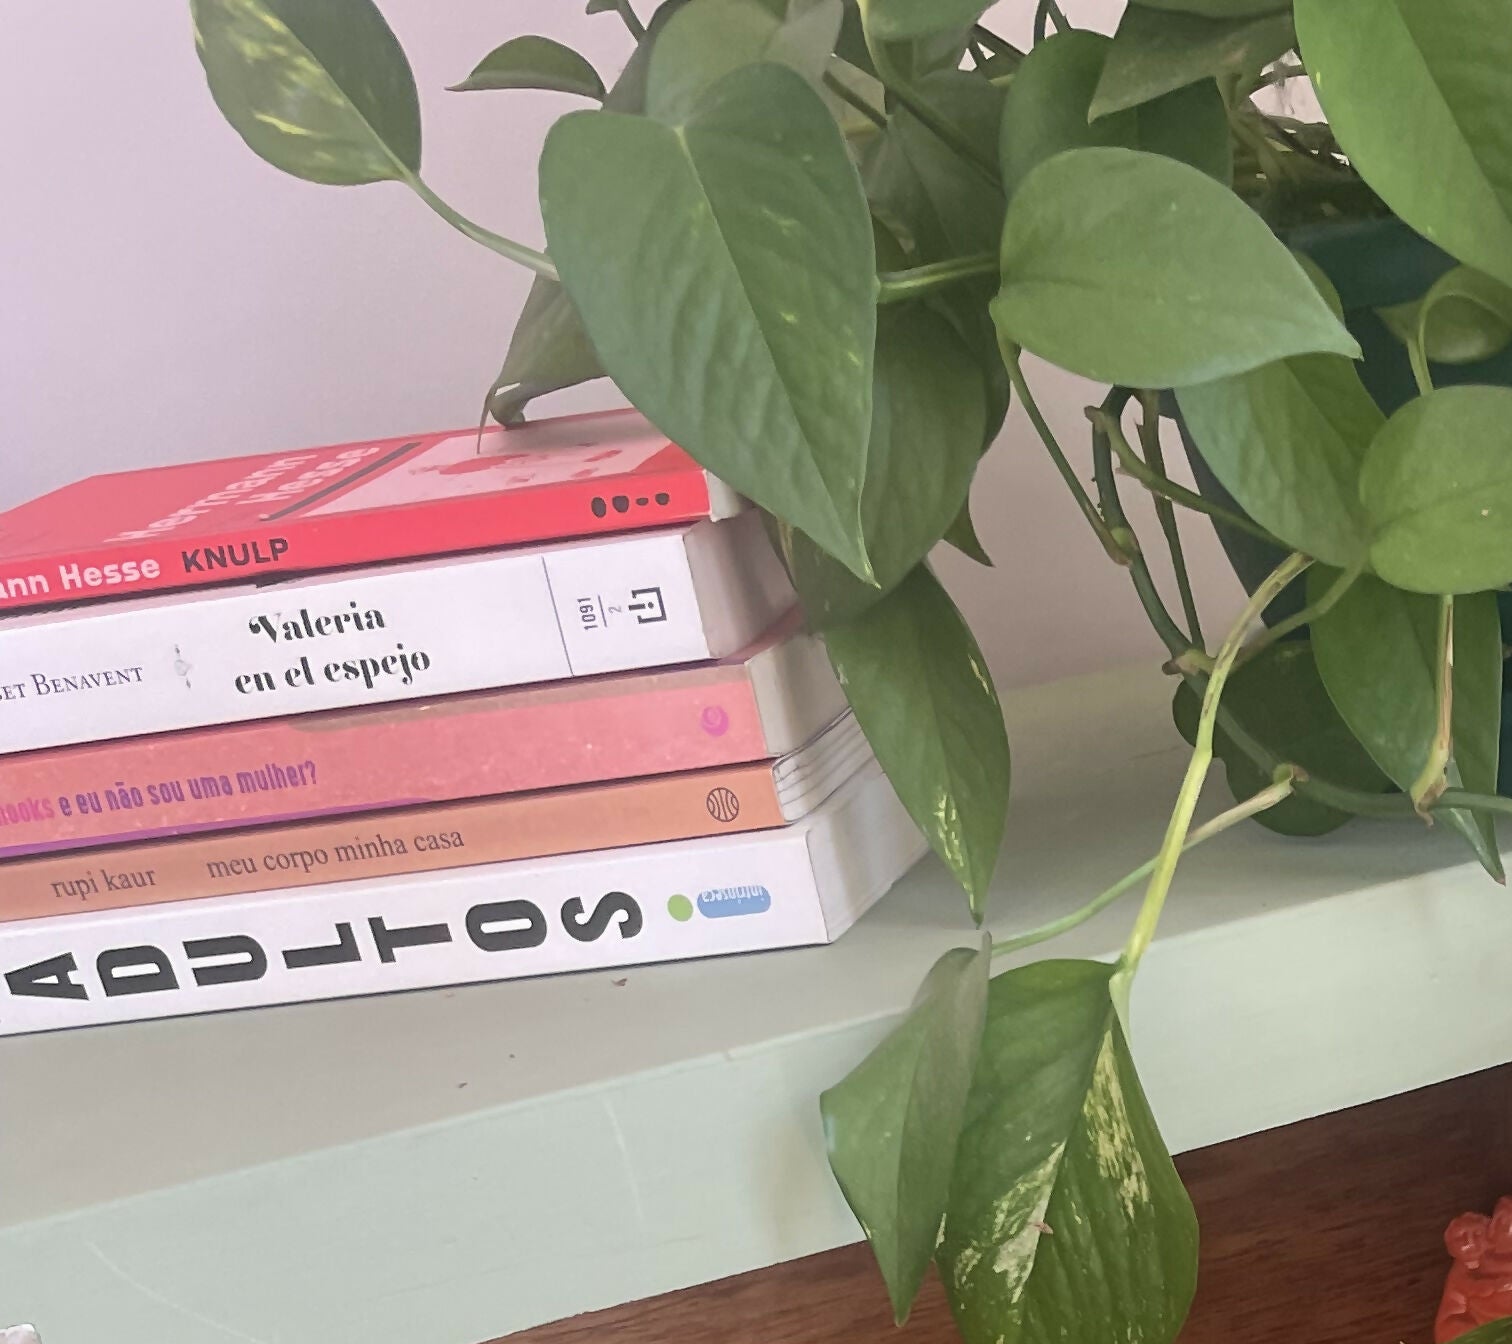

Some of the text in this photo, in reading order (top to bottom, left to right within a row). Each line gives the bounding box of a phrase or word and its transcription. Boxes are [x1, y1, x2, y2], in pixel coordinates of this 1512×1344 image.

[58, 559, 160, 590] Hesse
[182, 537, 289, 573] KNULP
[249, 602, 385, 643] Valeria
[578, 596, 599, 632] 1091
[234, 644, 431, 695] en el espejo
[59, 796, 72, 817] e
[76, 791, 102, 814] eu
[105, 781, 144, 811] não
[147, 778, 184, 806] sou
[190, 774, 233, 800] uma
[236, 759, 319, 795] mulher?
[51, 825, 466, 900] rupi kaur meu corpo minha casa
[3, 890, 644, 1001] ADULTOS
